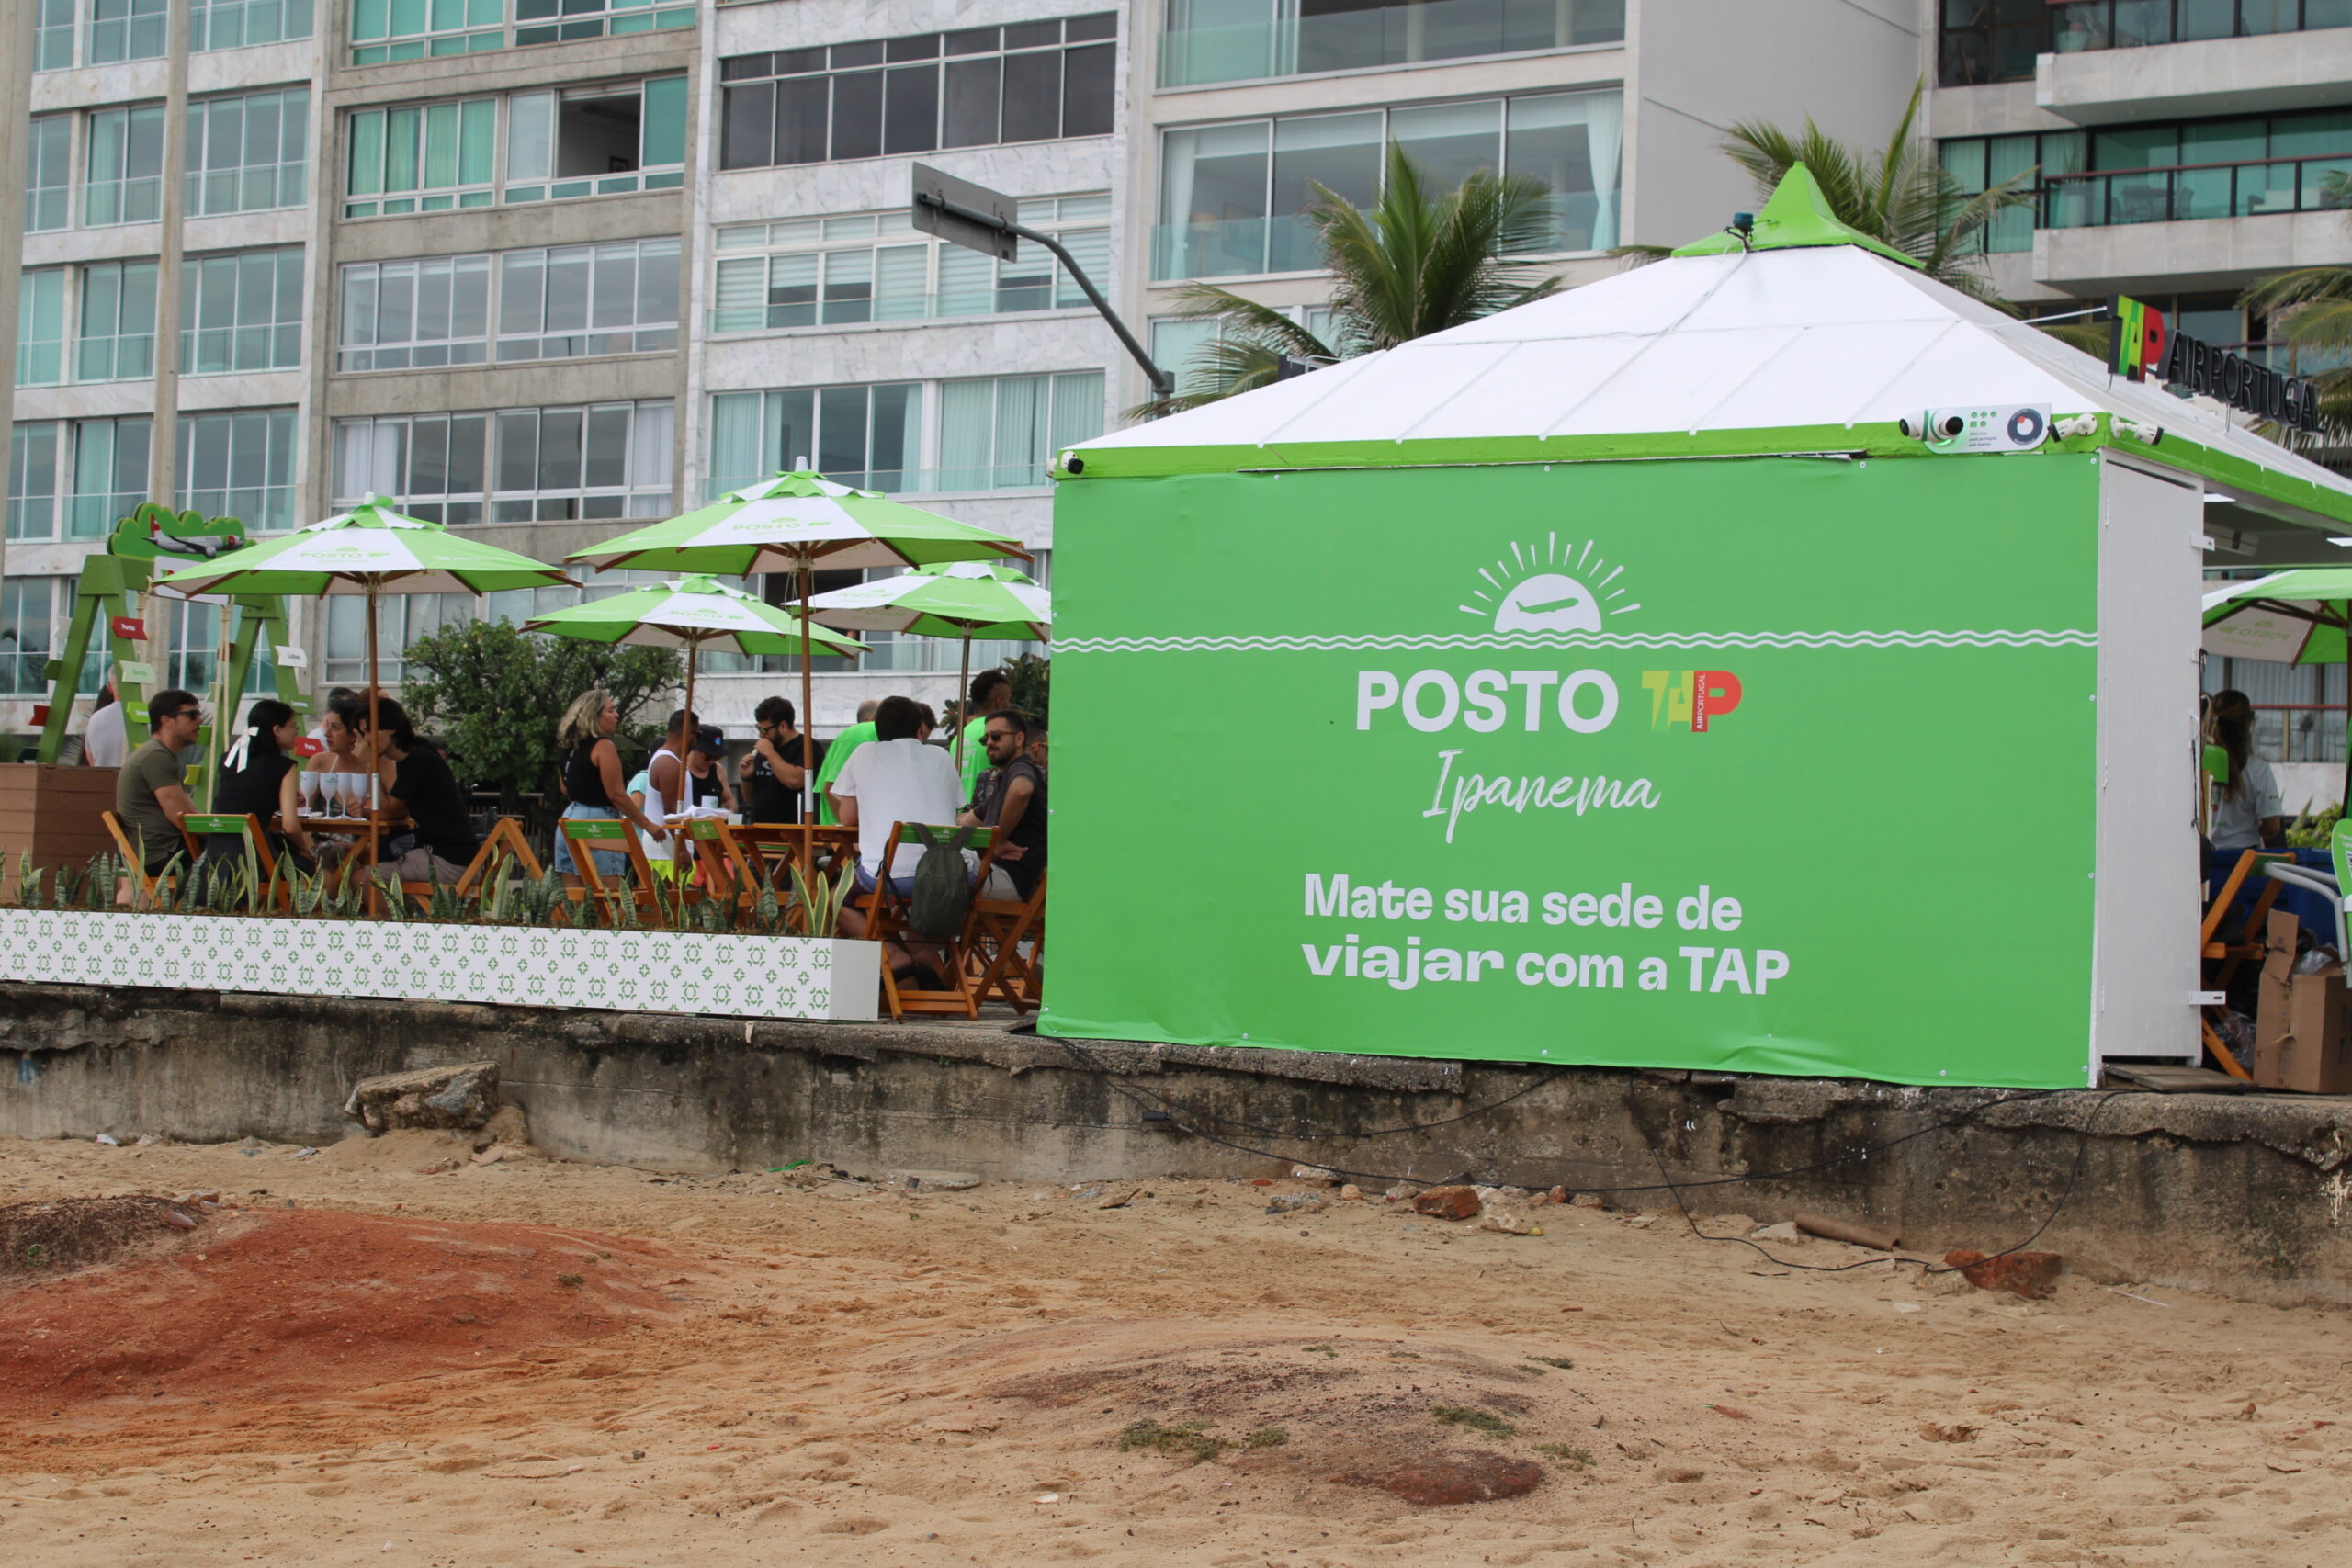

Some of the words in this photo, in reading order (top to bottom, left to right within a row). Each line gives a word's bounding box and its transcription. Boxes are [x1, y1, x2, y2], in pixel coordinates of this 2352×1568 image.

[2108, 294, 2165, 383] TAP
[1356, 669, 1620, 733] POSTO
[1641, 670, 1743, 733] TAP
[1423, 749, 1662, 844] Ipanema
[1305, 874, 1433, 920] Mate
[1444, 887, 1530, 925] sua
[1542, 882, 1664, 930] sede
[1676, 884, 1743, 931] de
[1301, 934, 1505, 991] viajar
[1515, 952, 1624, 989] com
[1638, 956, 1668, 991] a
[1679, 946, 1791, 995] TAP
